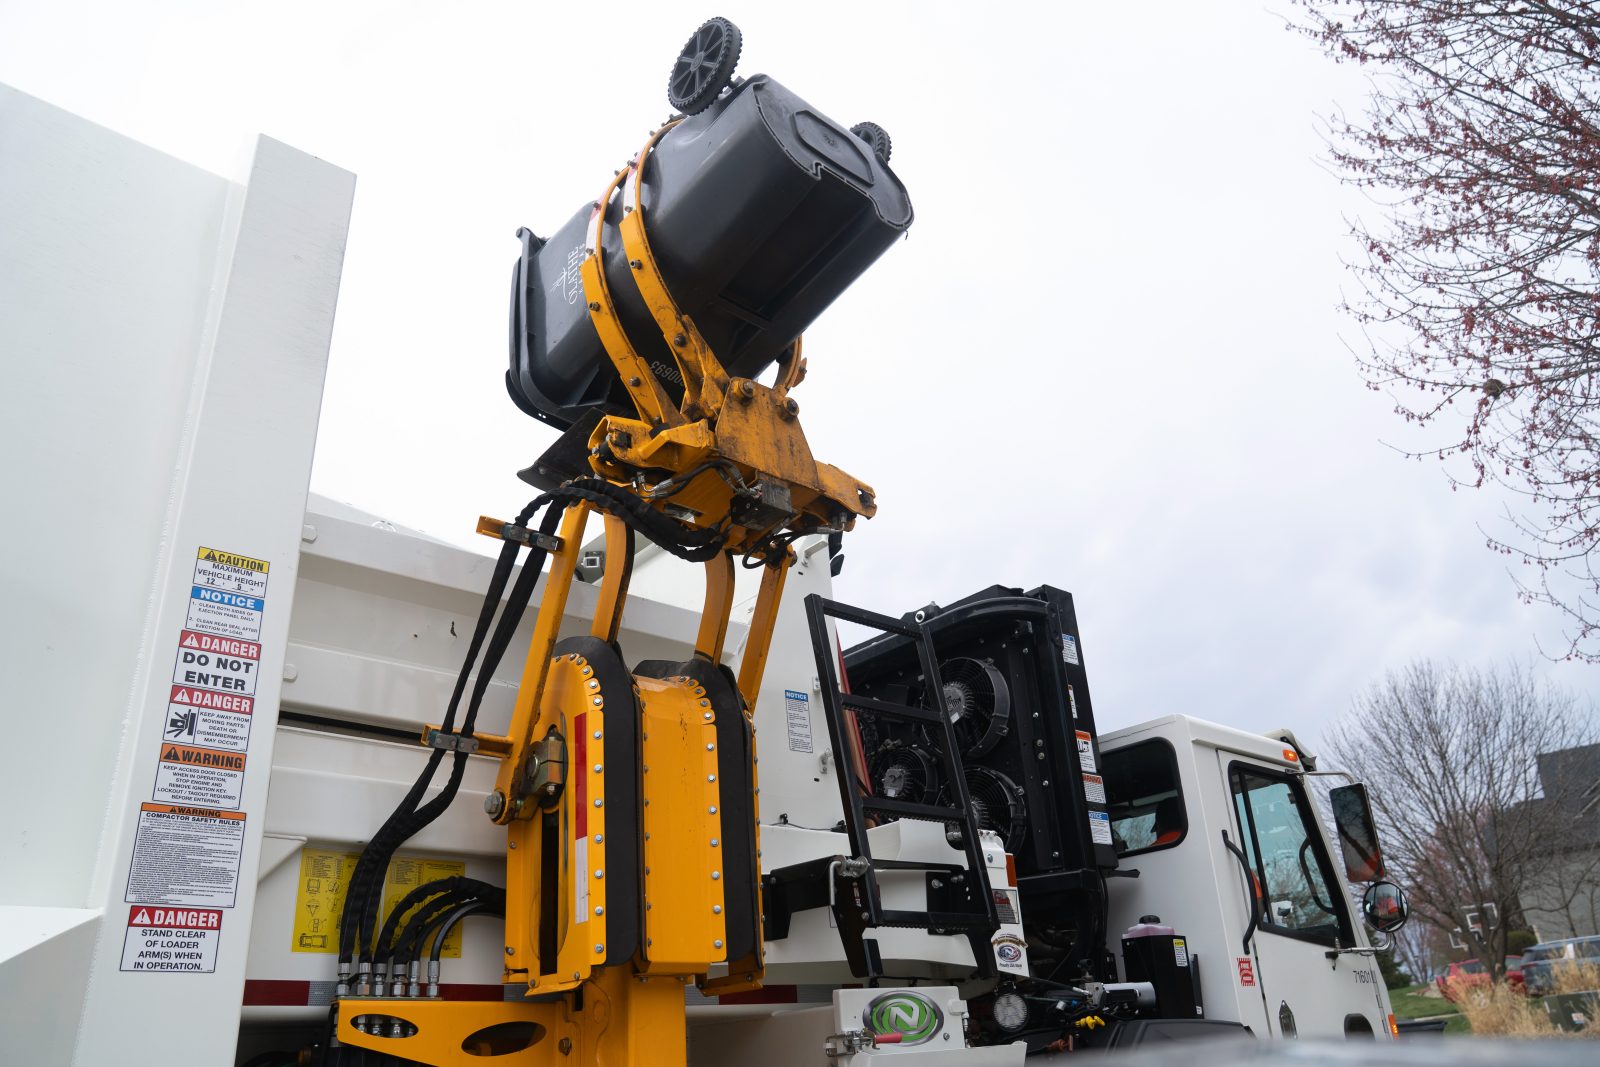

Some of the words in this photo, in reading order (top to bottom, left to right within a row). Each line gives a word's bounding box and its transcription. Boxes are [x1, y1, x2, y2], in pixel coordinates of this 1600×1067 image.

[567, 246, 579, 305] OLATHE
[651, 360, 683, 386] 00693
[212, 563, 253, 577] MAXIMUM
[218, 553, 264, 572] CAUTION
[197, 568, 233, 581] VEHICLE
[234, 576, 265, 588] HEIGHT
[200, 589, 255, 609] NOTICE
[201, 636, 258, 658] DANGER
[182, 651, 210, 666] DO
[215, 657, 254, 674] NOT
[184, 670, 246, 691] ENTER
[192, 691, 251, 712] DANGER
[786, 691, 807, 700] NOTICE
[201, 718, 225, 726] MOVING
[196, 729, 247, 742] DISMEMBERMENT
[181, 750, 243, 769] WARNING
[178, 766, 200, 774] ACCESS
[145, 812, 190, 821] COMPACTOR
[191, 816, 217, 824] SAFETY
[177, 807, 222, 818] WARNING
[153, 909, 219, 928] DANGER
[141, 928, 173, 938] STAND
[175, 930, 206, 939] CLEAR
[145, 940, 159, 948] OF
[160, 940, 199, 949] LOADER
[137, 950, 172, 960] ARM(S)
[174, 951, 203, 960] WHEN
[133, 961, 144, 969] IN
[146, 961, 203, 971] OPERATION.
